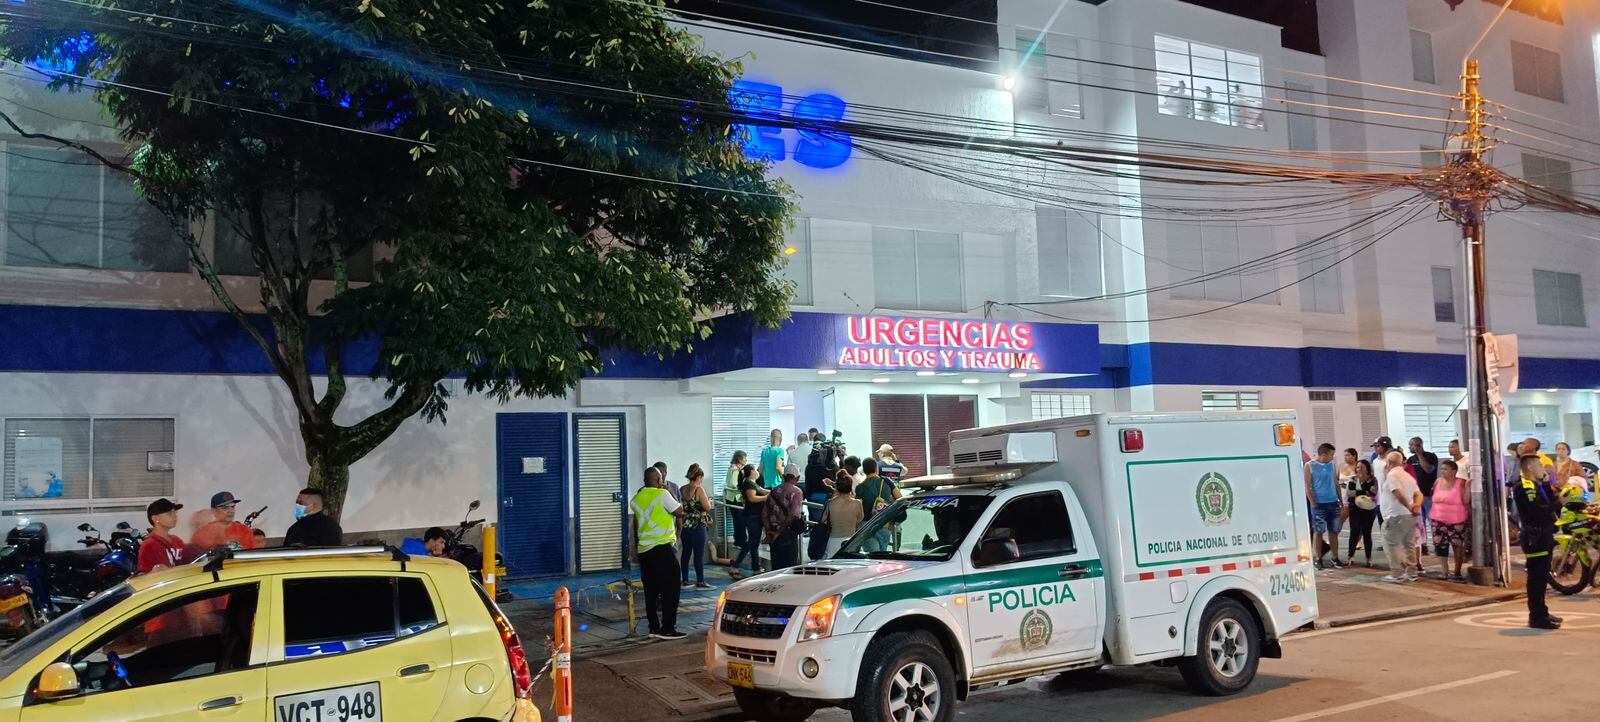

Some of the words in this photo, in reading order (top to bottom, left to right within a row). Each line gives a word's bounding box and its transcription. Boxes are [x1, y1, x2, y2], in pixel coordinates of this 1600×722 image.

[848, 315, 1033, 351] URGENCIAS
[839, 346, 939, 368] ADULTOS
[940, 350, 956, 368] Y
[958, 351, 1043, 370] TRAUMA
[1148, 541, 1182, 554] POLICIA
[1186, 536, 1228, 550] NACIONAL
[1232, 534, 1242, 546] DE
[1247, 530, 1287, 544] COLOMBIA
[1270, 571, 1306, 596] 27-2460
[988, 584, 1076, 612] POLICIA
